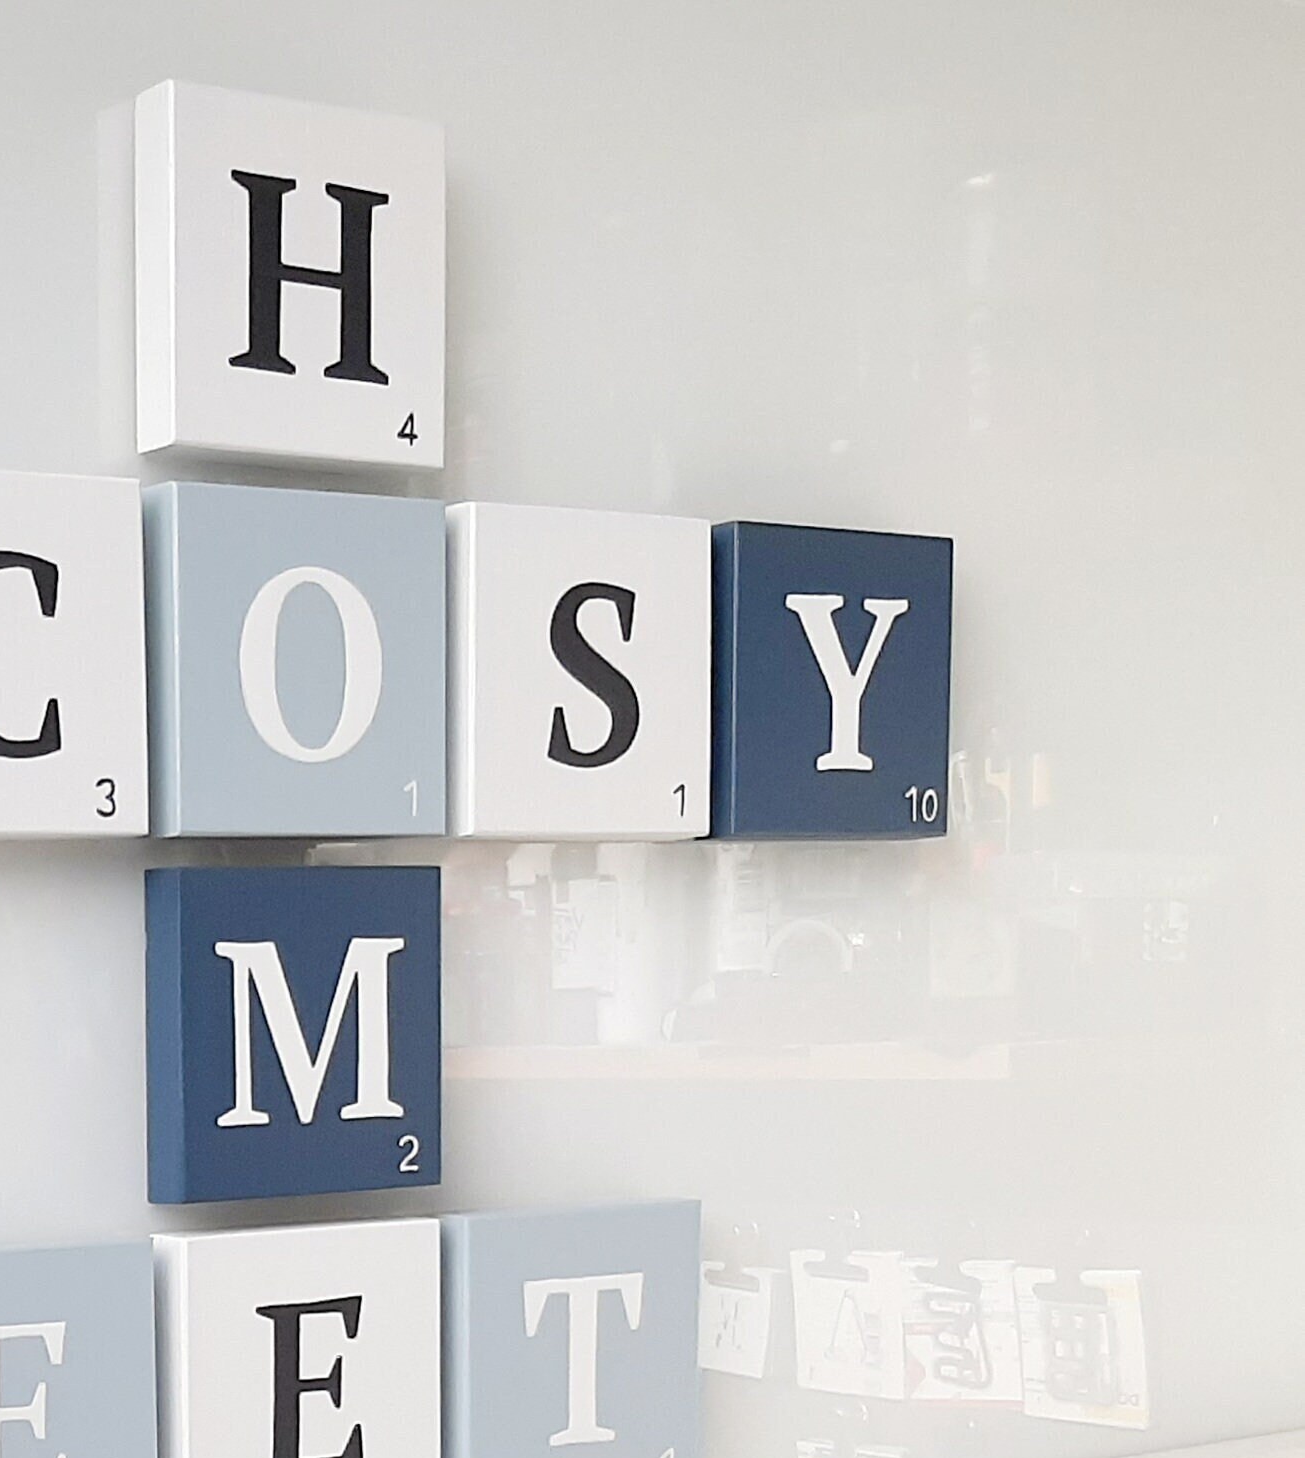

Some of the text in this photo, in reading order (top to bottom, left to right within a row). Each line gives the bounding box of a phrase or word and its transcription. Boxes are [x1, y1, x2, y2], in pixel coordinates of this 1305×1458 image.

[397, 412, 418, 446] 4
[96, 777, 117, 818] 3
[403, 780, 418, 817] 1
[673, 783, 687, 818] 1
[904, 786, 939, 823] 10
[399, 1135, 420, 1172] 2
